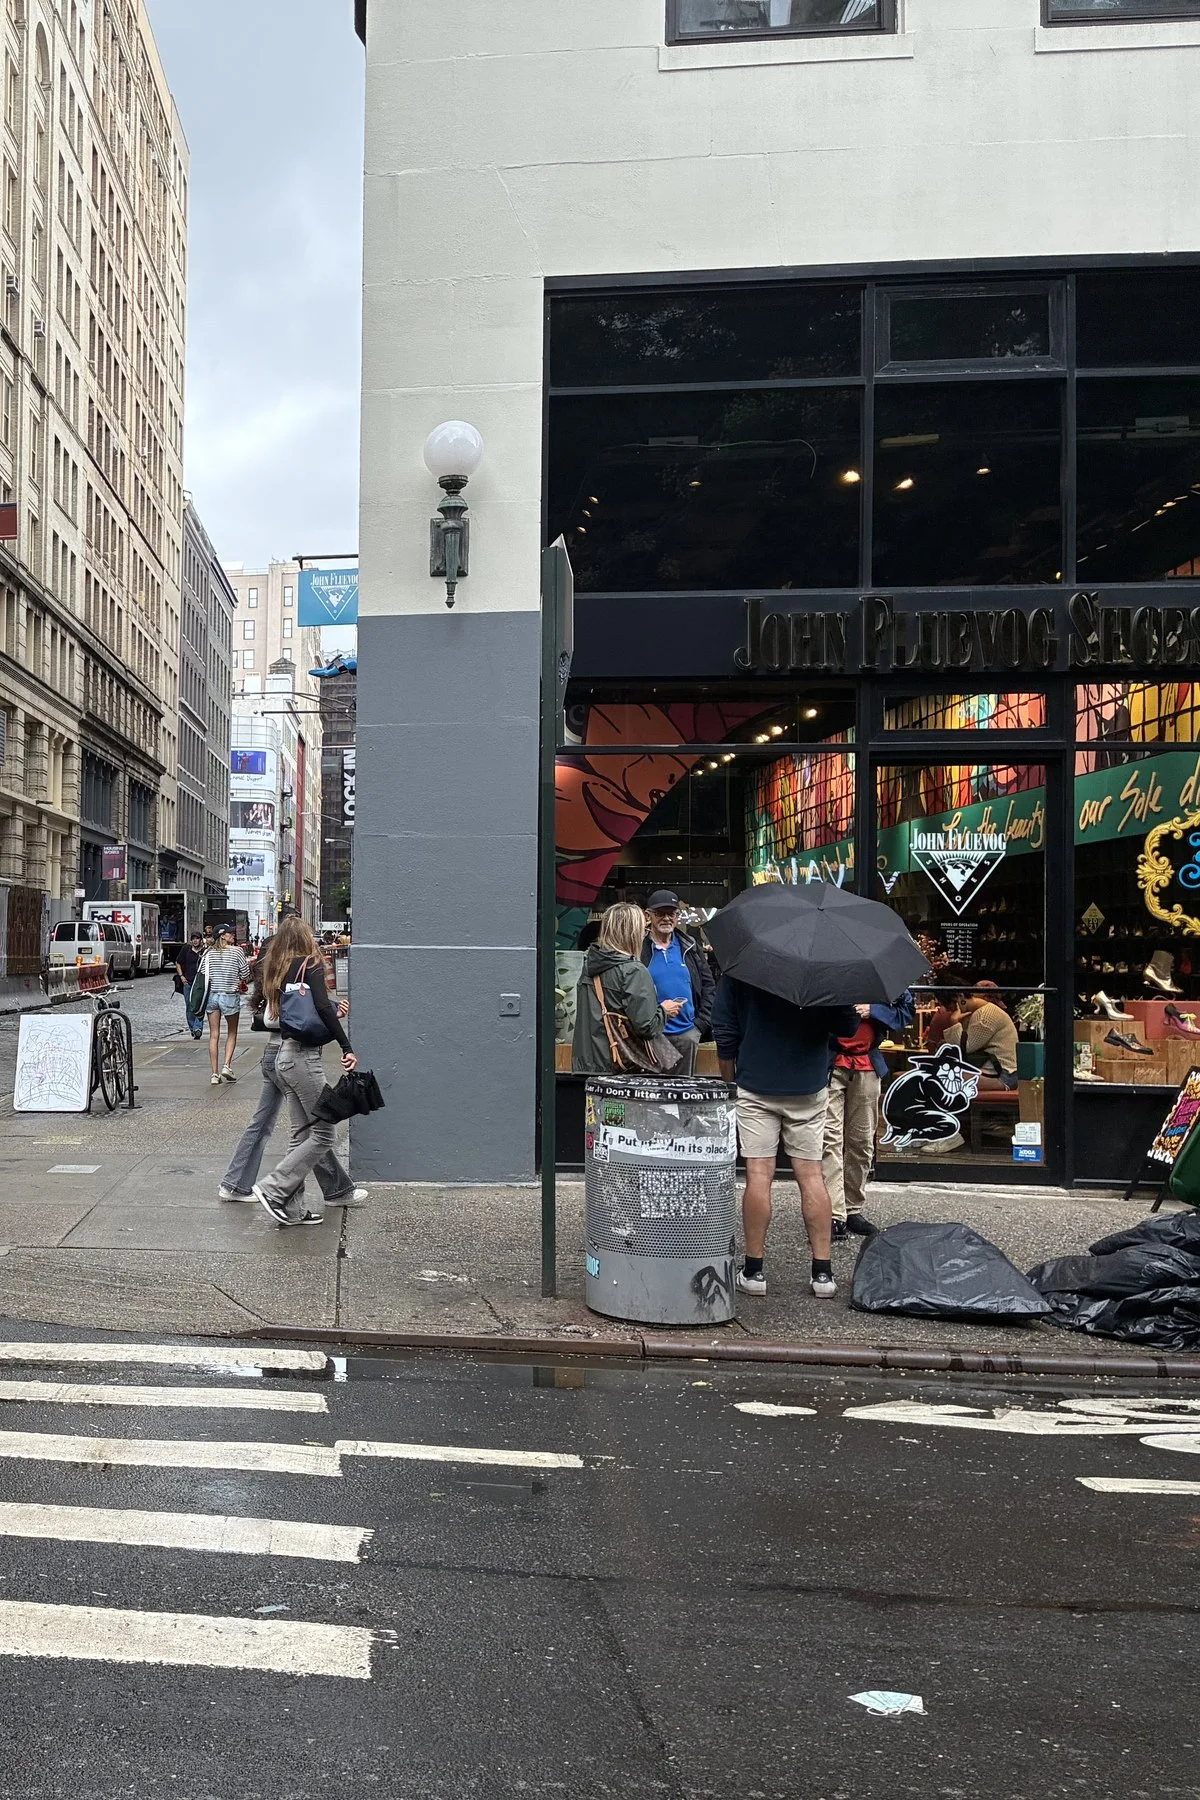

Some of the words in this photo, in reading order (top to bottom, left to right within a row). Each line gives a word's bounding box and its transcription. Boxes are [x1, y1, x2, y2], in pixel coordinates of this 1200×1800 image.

[310, 573, 329, 586] JOHN
[733, 597, 849, 671] JOHN
[859, 594, 1060, 672] FLUEVOG
[343, 749, 356, 770] IN
[343, 771, 356, 826] LOCK
[1079, 796, 1113, 831] our
[909, 828, 946, 850] JOHN
[949, 828, 1007, 850] FLUEVOG
[90, 910, 132, 923] FedEx
[606, 1087, 632, 1097] Don't
[634, 1088, 661, 1100] litter
[682, 1090, 710, 1100] Don't
[618, 1135, 637, 1147] Put
[673, 1144, 686, 1153] in
[688, 1143, 703, 1154] its
